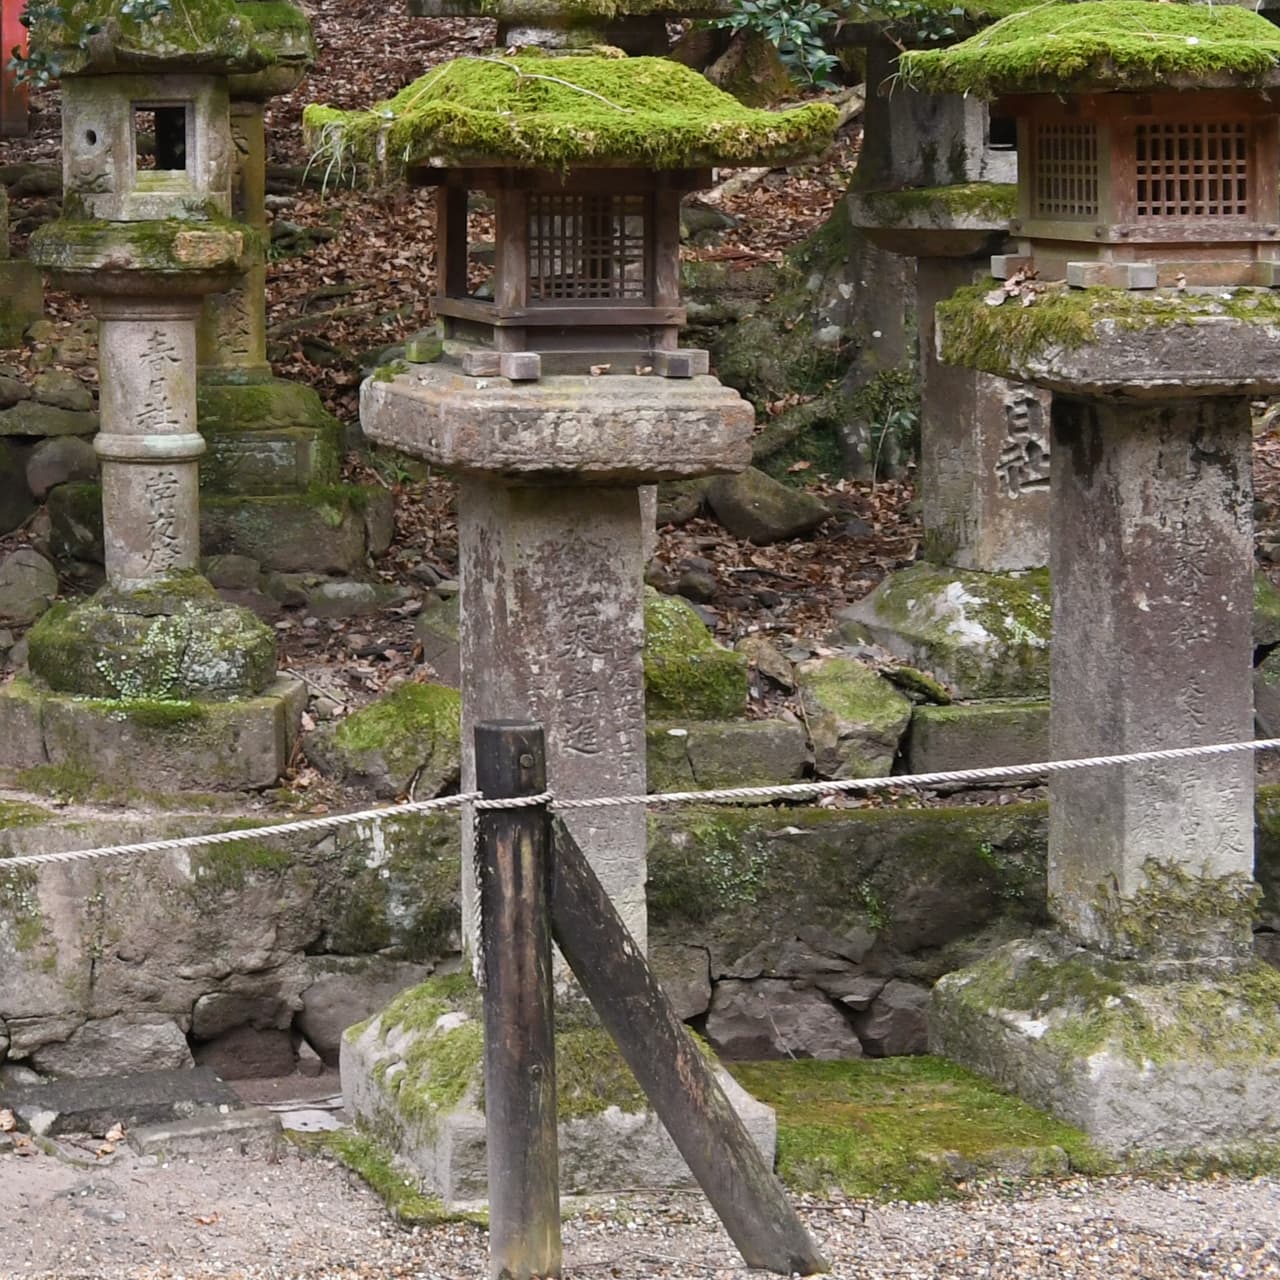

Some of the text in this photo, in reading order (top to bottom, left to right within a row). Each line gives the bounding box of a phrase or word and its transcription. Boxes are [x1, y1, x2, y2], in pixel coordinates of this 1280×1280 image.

[135, 330, 183, 428] 春日社
[996, 382, 1052, 496] 日社
